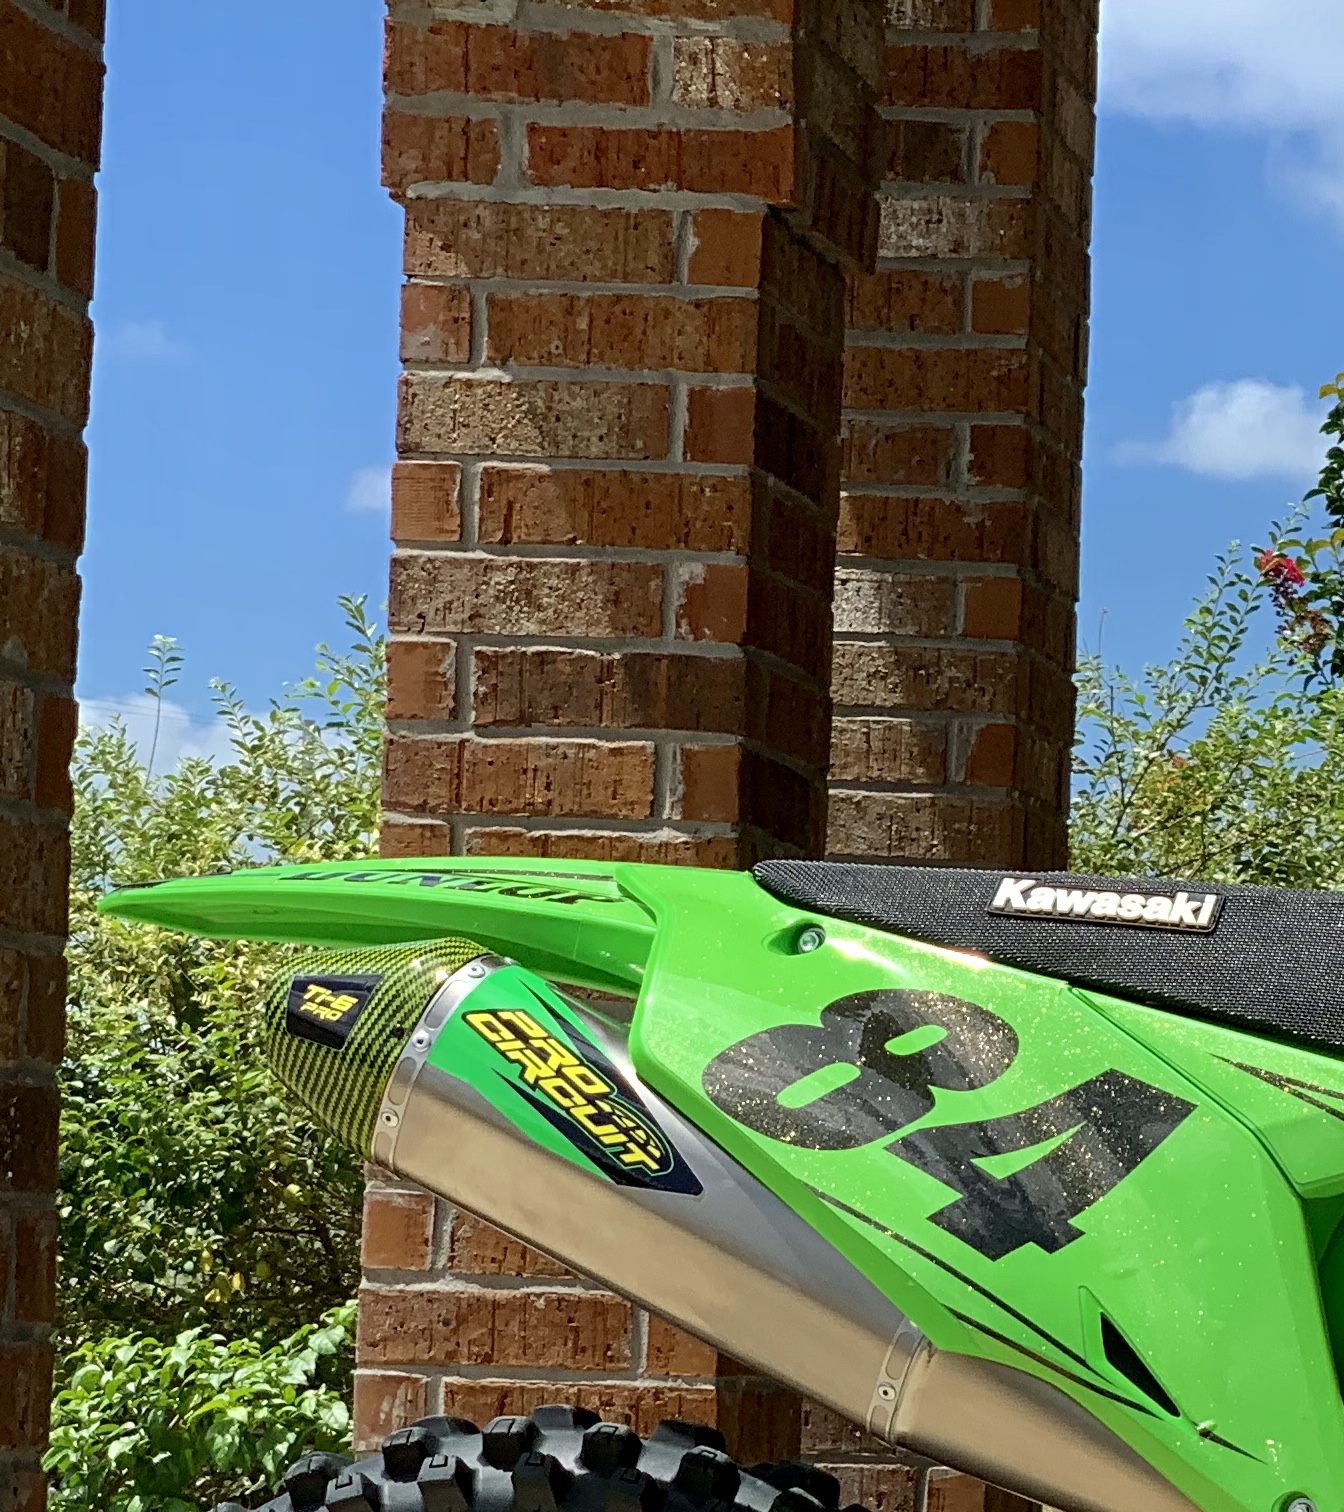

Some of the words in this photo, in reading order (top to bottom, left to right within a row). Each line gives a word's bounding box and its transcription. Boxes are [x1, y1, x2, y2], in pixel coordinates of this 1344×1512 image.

[993, 877, 1218, 927] Kawasaki
[299, 1001, 343, 1022] PRO
[496, 1010, 612, 1095] PRO
[464, 1012, 661, 1171] CIRCUIT
[702, 987, 1200, 1263] 84
